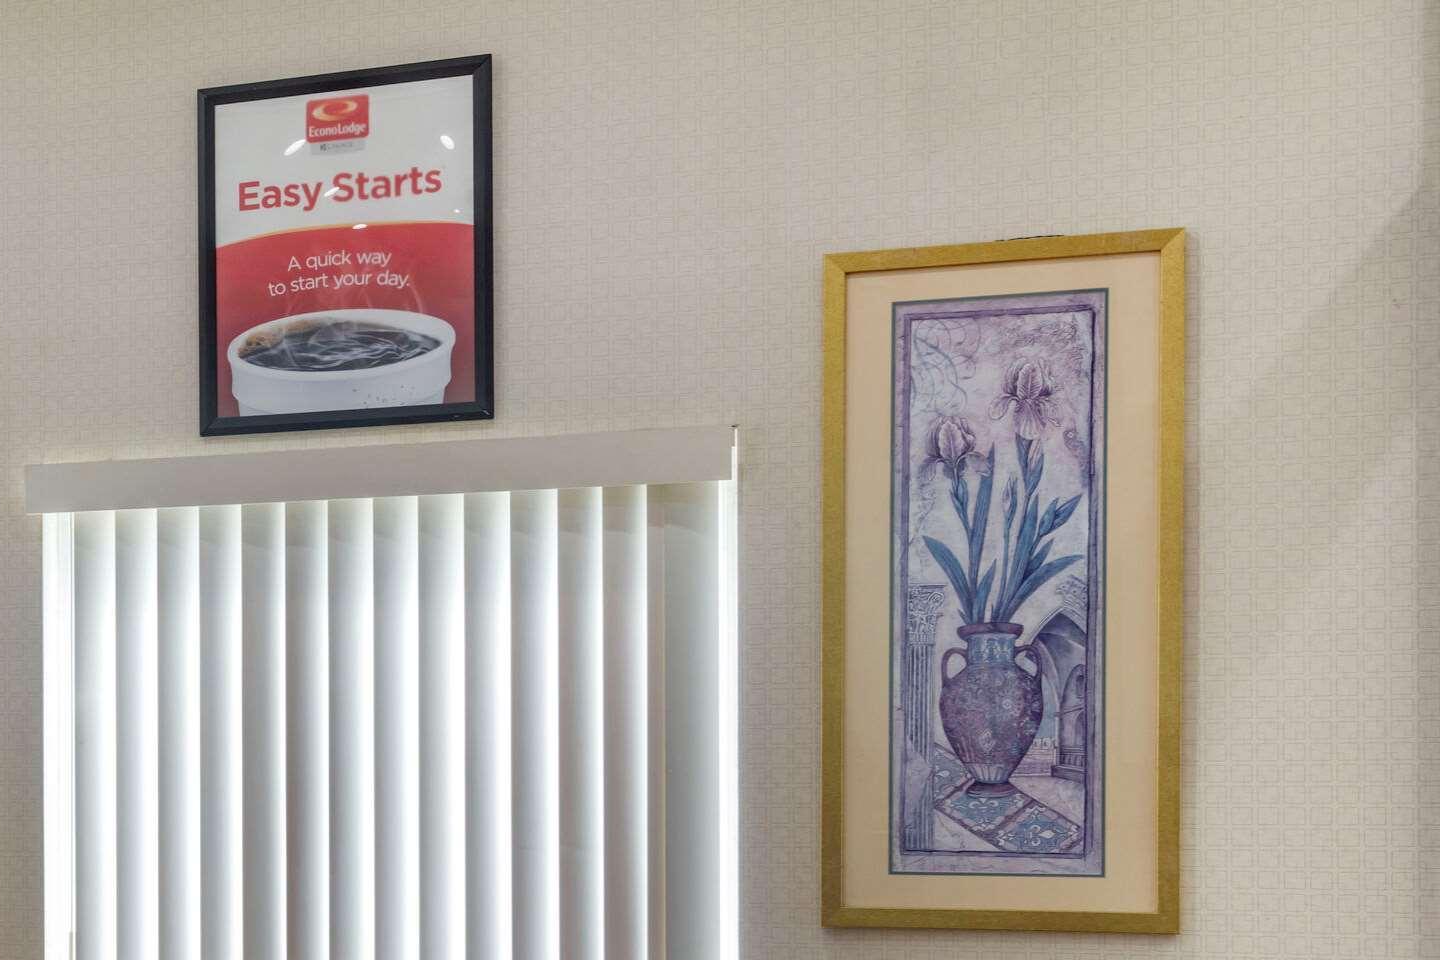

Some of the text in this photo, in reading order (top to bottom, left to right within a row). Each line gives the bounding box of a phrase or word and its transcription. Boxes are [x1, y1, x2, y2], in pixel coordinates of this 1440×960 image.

[238, 166, 442, 212] Easy Starts
[287, 250, 392, 271] A quick way
[268, 269, 410, 297] to start your day.
